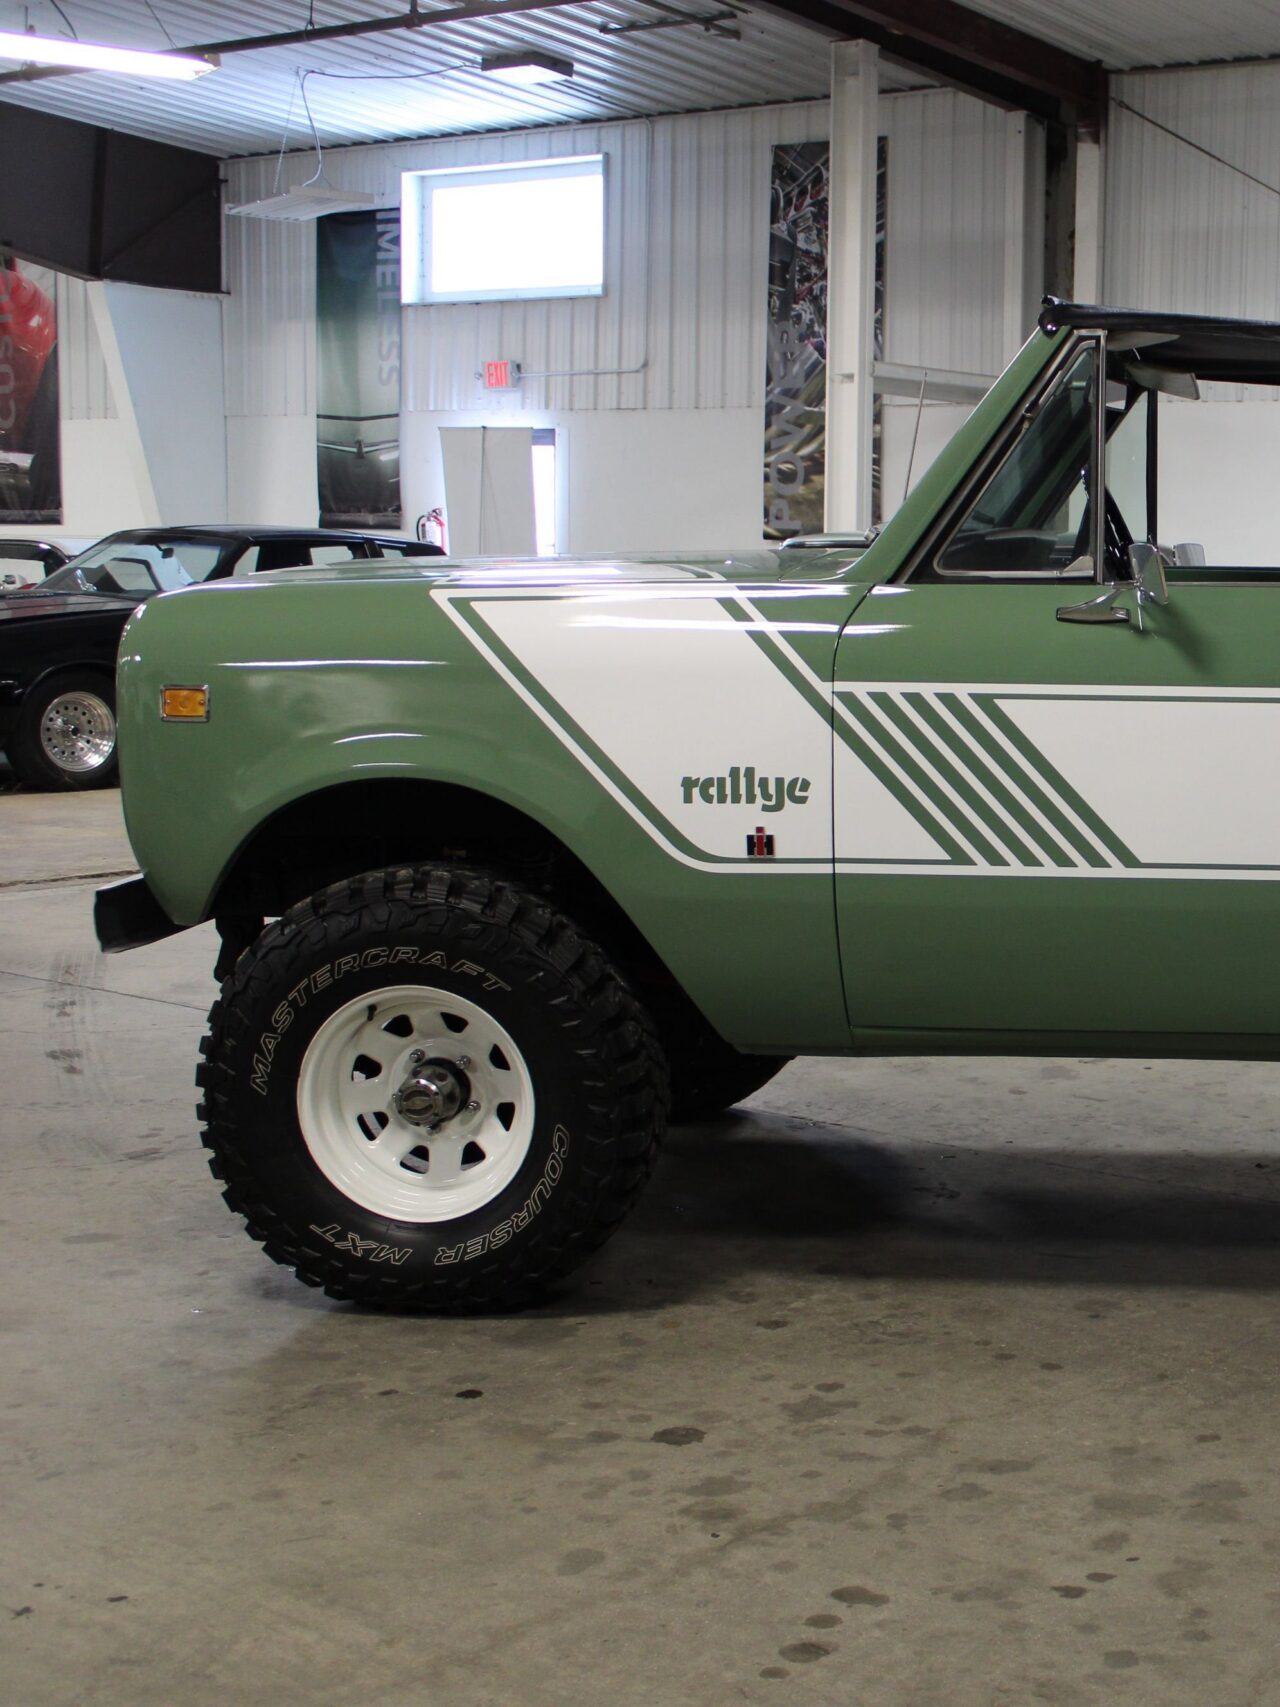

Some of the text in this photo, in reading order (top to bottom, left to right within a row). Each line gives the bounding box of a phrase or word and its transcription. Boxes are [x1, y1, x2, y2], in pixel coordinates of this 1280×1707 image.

[487, 361, 509, 387] EXIT
[769, 319, 806, 530] POWER
[680, 766, 811, 813] rallye
[250, 946, 512, 1096] MASTERCRAFT
[309, 1124, 570, 1266] COURSER MXT
